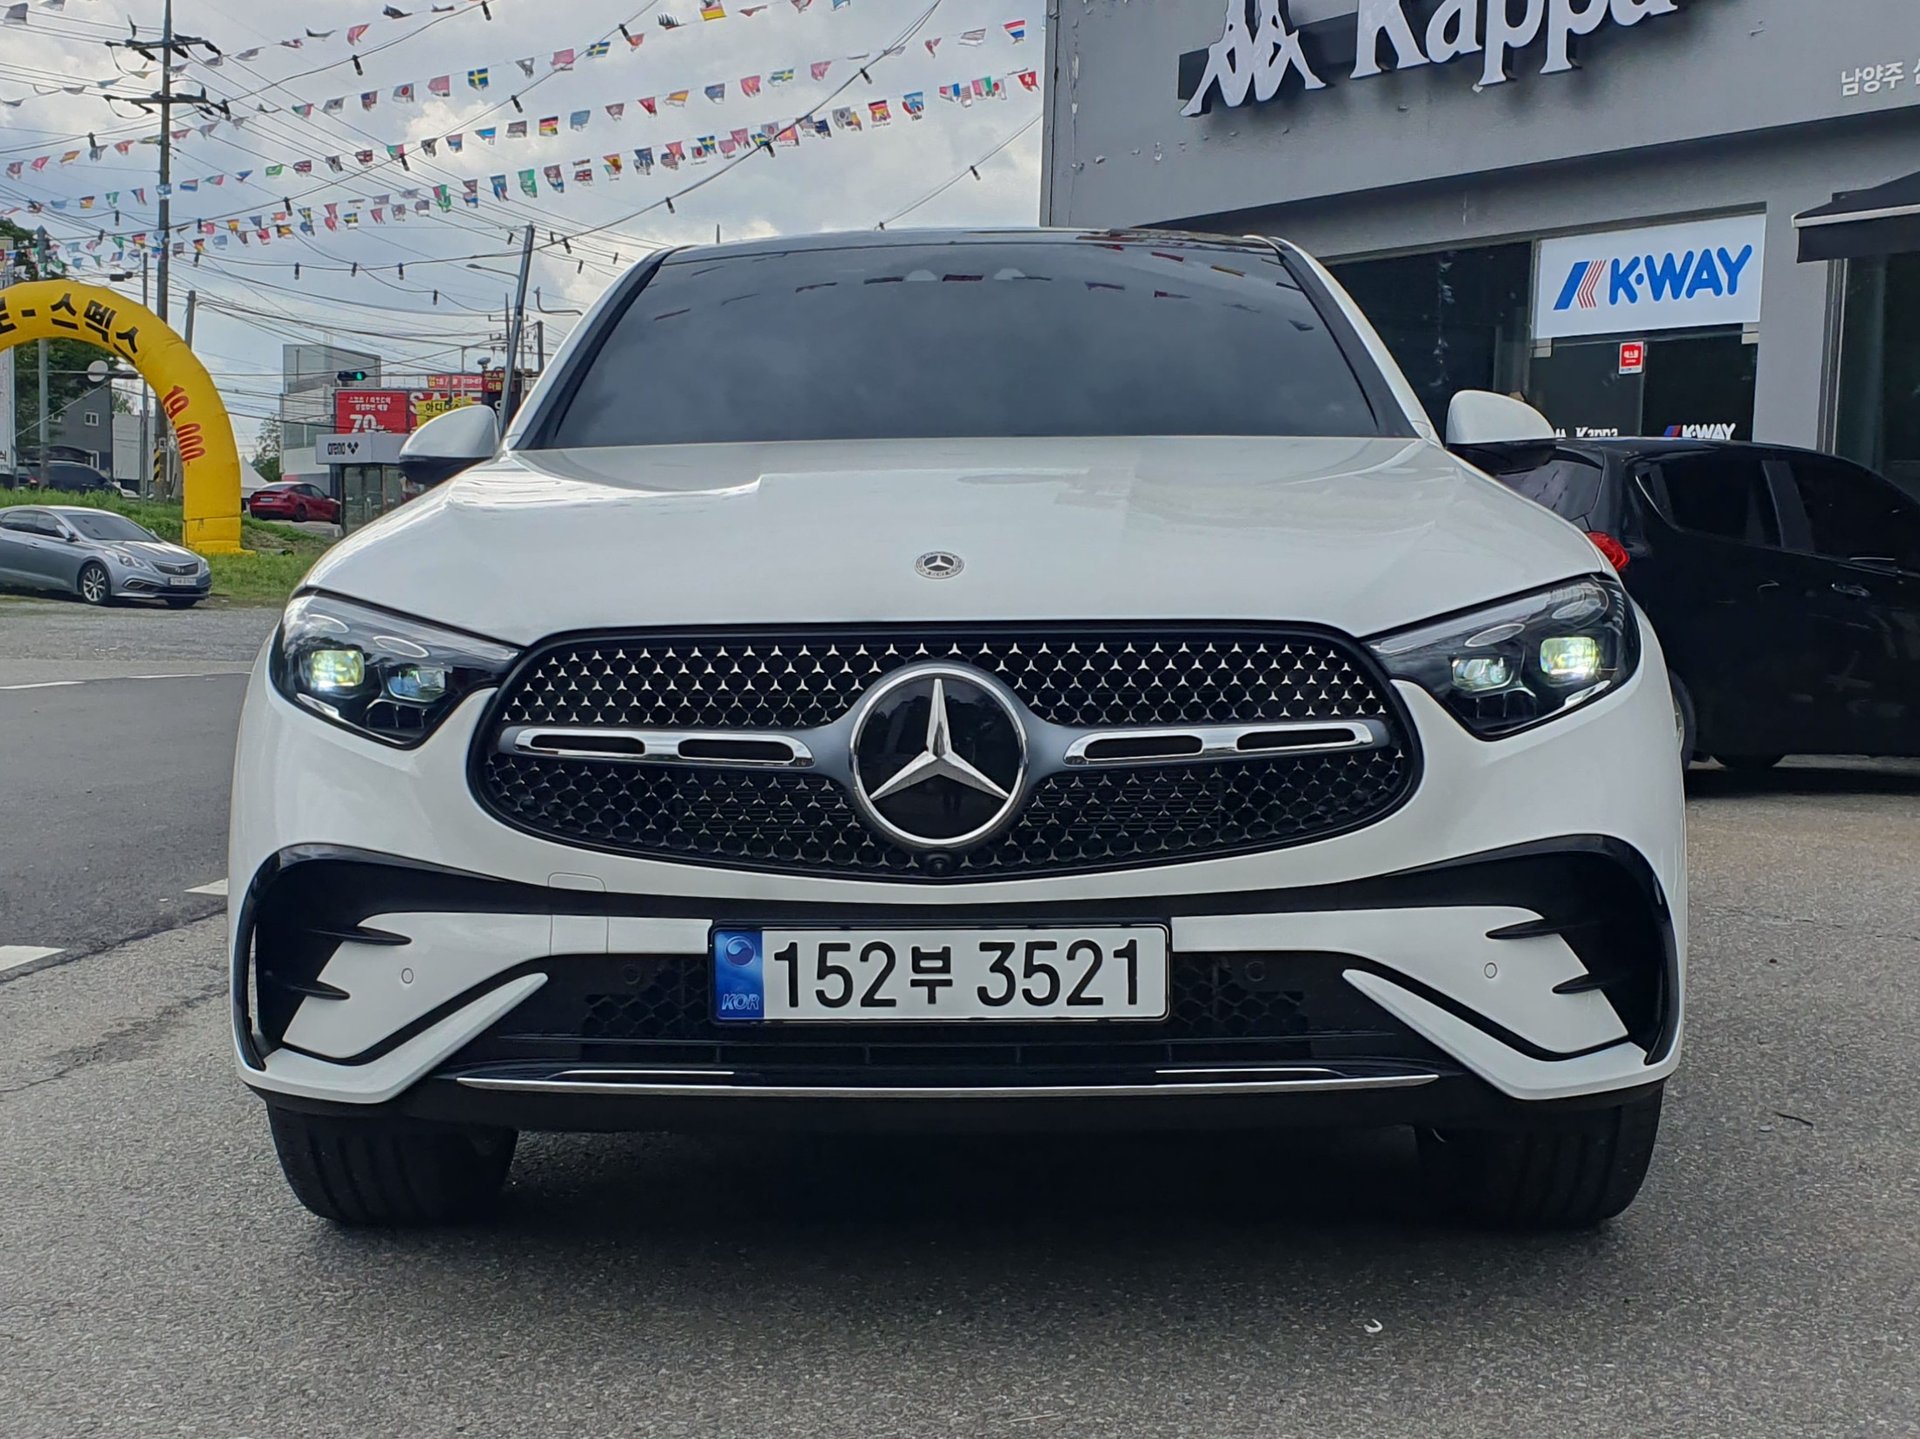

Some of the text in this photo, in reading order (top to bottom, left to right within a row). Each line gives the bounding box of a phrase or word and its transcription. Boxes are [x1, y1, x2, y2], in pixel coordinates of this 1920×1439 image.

[1841, 62, 1904, 96] 남양주
[774, 939, 1138, 1008] 152부 3521
[720, 993, 761, 1011] KOR
